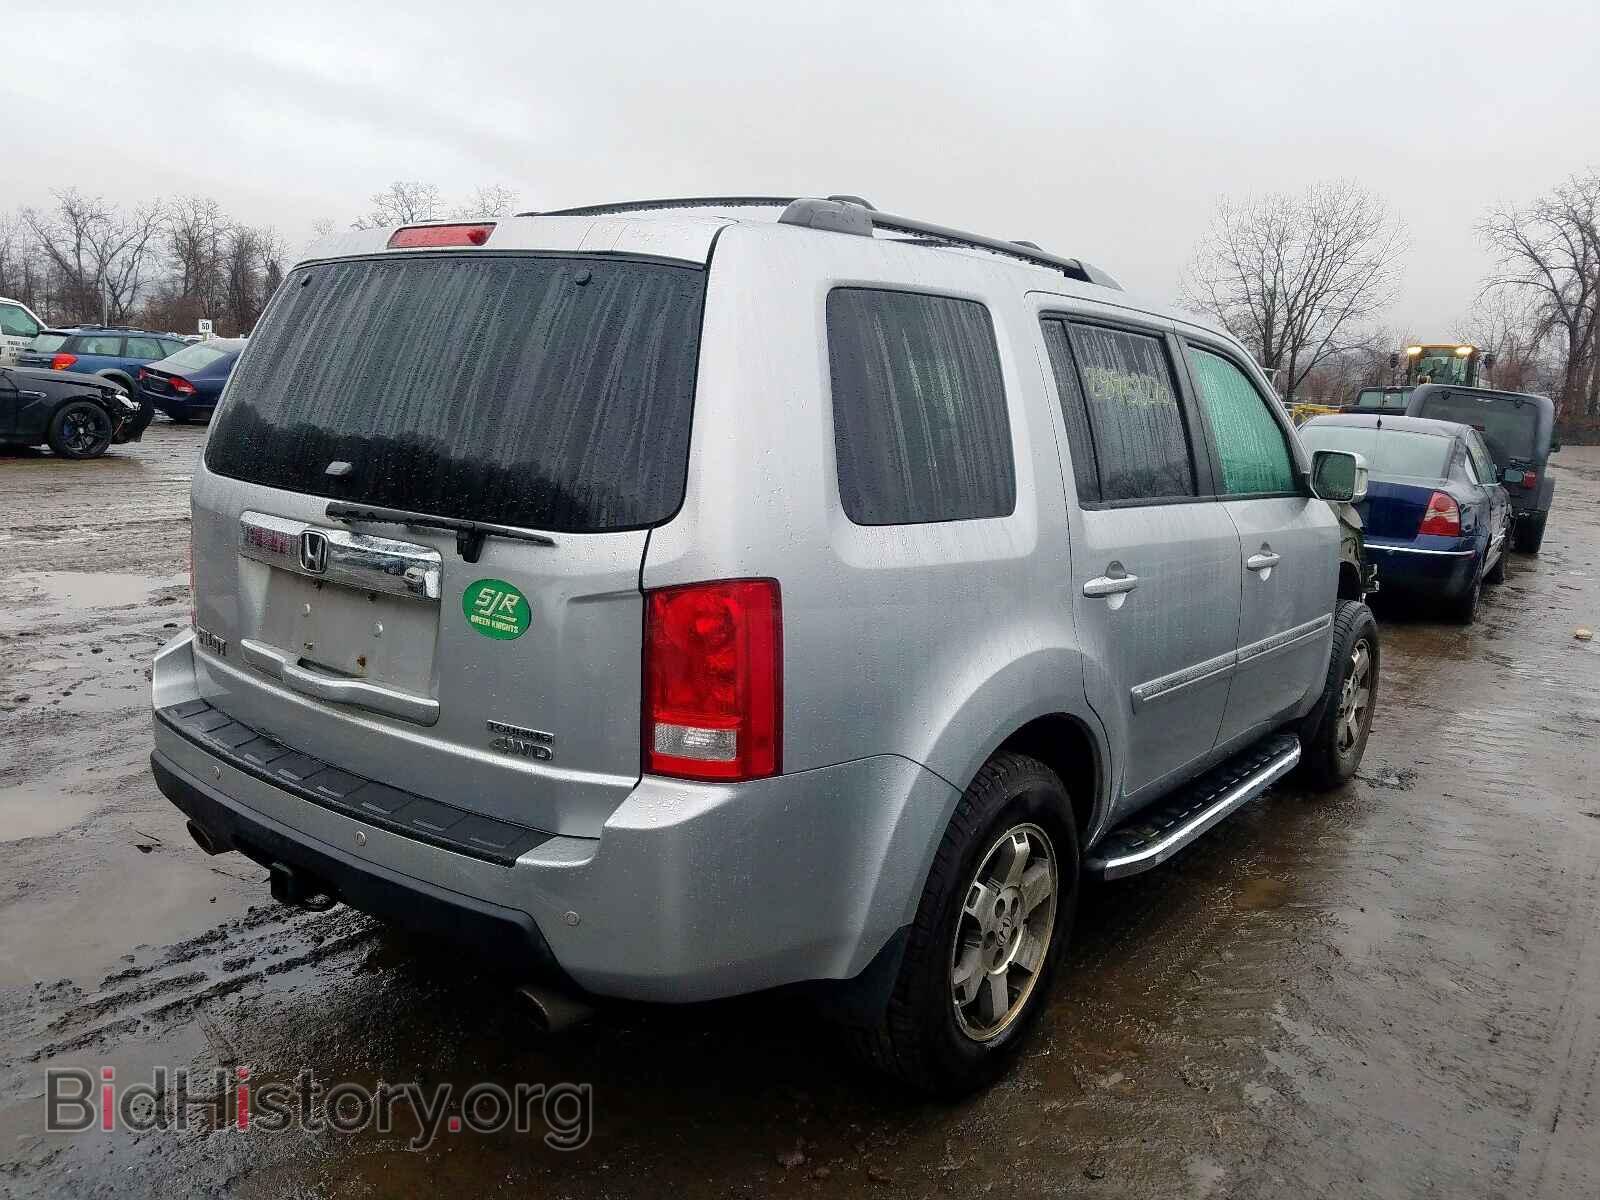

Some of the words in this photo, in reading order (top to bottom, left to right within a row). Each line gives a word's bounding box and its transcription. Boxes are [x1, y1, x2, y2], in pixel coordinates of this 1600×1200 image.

[474, 587, 520, 616] SJR
[470, 614, 491, 627] GREEN
[491, 619, 519, 634] KNIGHTS
